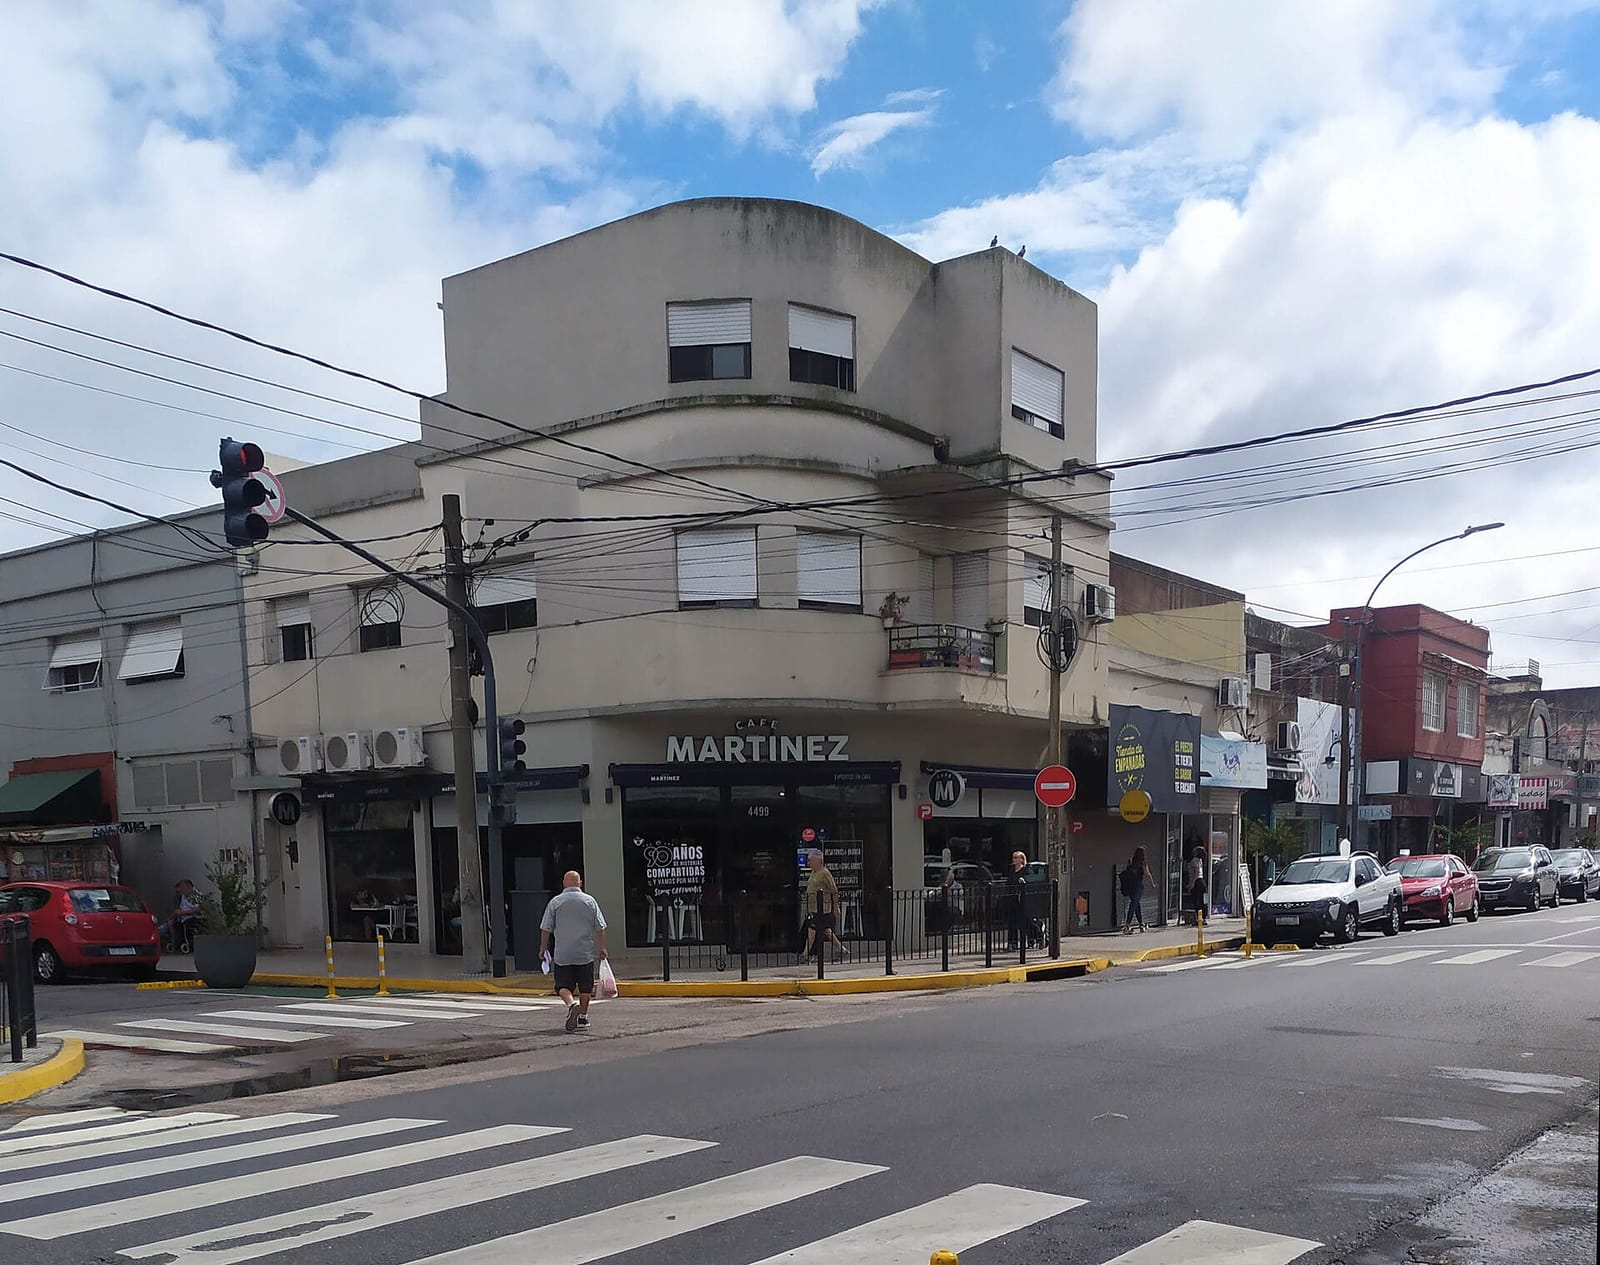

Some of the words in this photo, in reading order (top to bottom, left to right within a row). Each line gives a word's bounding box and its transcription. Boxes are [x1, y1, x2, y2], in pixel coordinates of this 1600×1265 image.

[735, 718, 778, 730] CAFE
[666, 735, 849, 763] MARTINEZ
[1115, 754, 1145, 773] EMPANADAS
[935, 780, 954, 801] M
[1548, 778, 1564, 788] NCH
[1519, 789, 1545, 798] adas
[278, 803, 297, 820] M
[747, 806, 769, 817] 4499
[644, 846, 673, 868] 90
[673, 843, 703, 861] AÑOS
[646, 866, 705, 879] COMPARTIDAS
